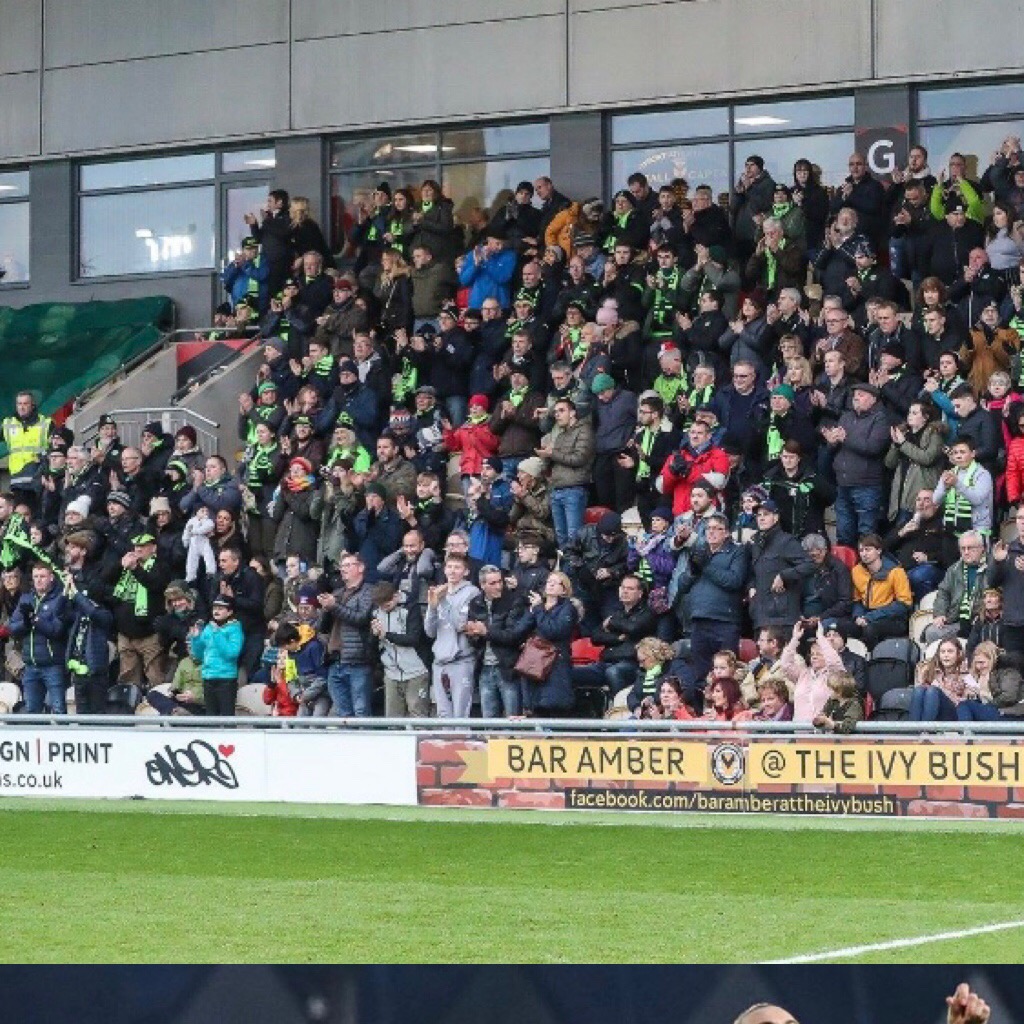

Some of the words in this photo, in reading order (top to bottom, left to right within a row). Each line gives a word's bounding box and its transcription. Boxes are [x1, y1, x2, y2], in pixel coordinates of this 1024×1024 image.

[868, 139, 896, 175] G
[48, 742, 114, 764] PRINT
[507, 744, 568, 774] BAR
[576, 746, 685, 776] AMBER
[795, 750, 857, 780] THE
[867, 751, 918, 781] IVY
[928, 751, 1021, 782] BUSH
[0, 770, 63, 789] s.co.uk
[569, 790, 895, 816] facebook.com/baramberattheivybush
